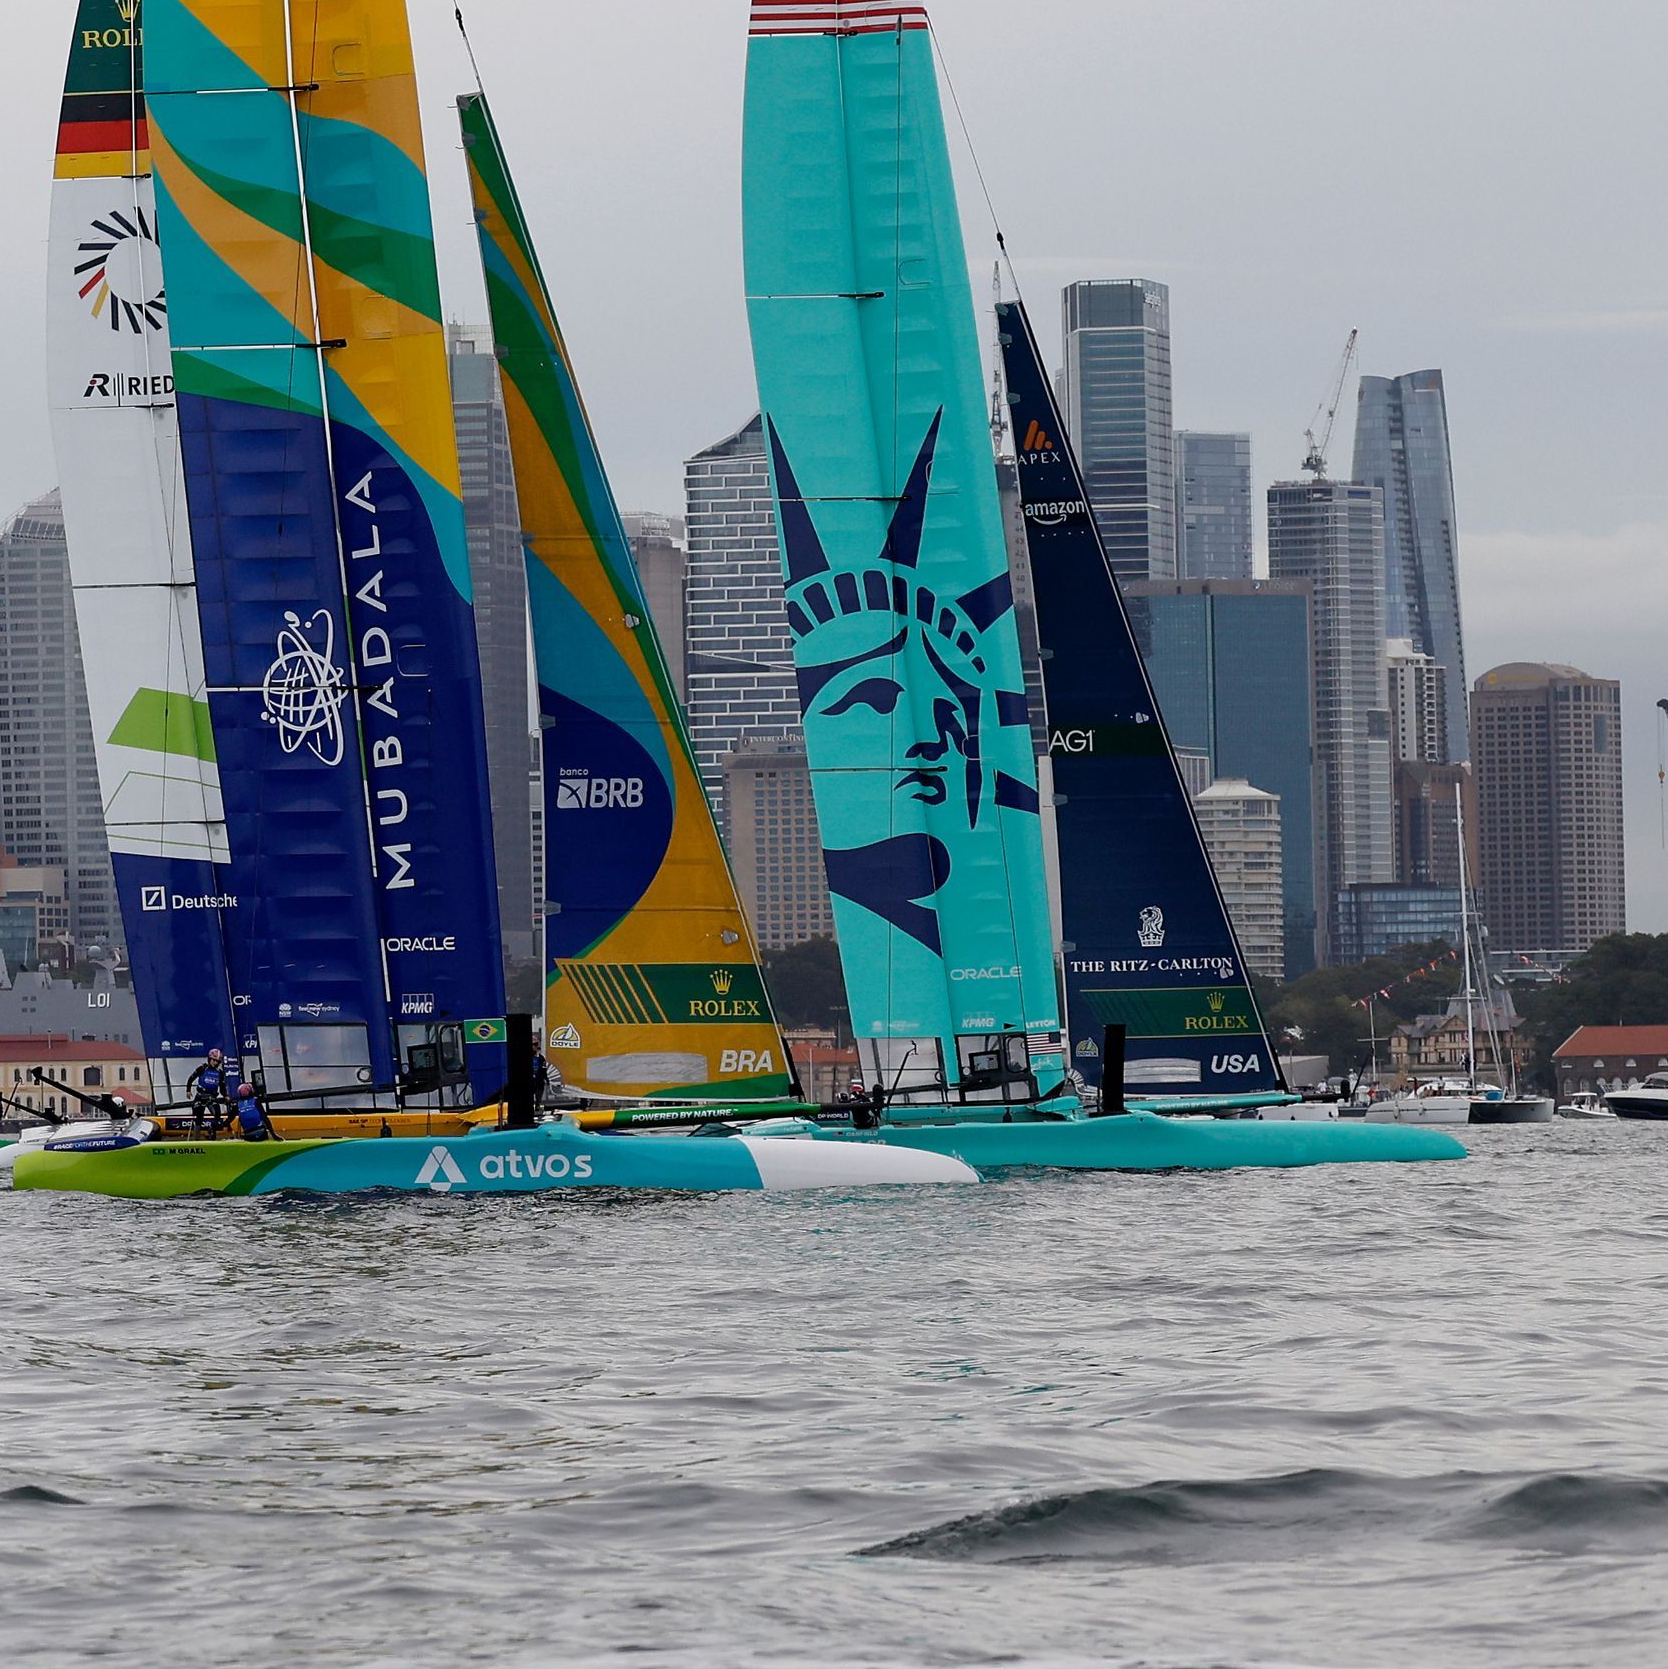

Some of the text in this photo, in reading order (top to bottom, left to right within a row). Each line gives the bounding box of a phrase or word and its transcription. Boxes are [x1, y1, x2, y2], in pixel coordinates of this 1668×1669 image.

[1018, 451, 1061, 465] APEX
[1025, 500, 1085, 517] amazon
[345, 470, 415, 890] MUBADALA
[1049, 730, 1093, 752] AG1
[559, 767, 589, 776] banco
[589, 778, 643, 808] BRB
[386, 936, 456, 952] ORACLE
[950, 966, 1022, 980] ORACLE
[1070, 960, 1105, 973] THE
[401, 1002, 434, 1014] KPMG
[689, 1000, 762, 1016] ROLEX
[962, 1018, 995, 1028] KPMG
[1185, 1016, 1249, 1030] ROLEX
[719, 1049, 773, 1073] BRA
[1211, 1054, 1260, 1074] USA
[632, 1111, 679, 1123] POWERED
[679, 1111, 692, 1119] BY
[178, 1147, 207, 1155] GRAEL
[479, 1149, 593, 1179] atvos
